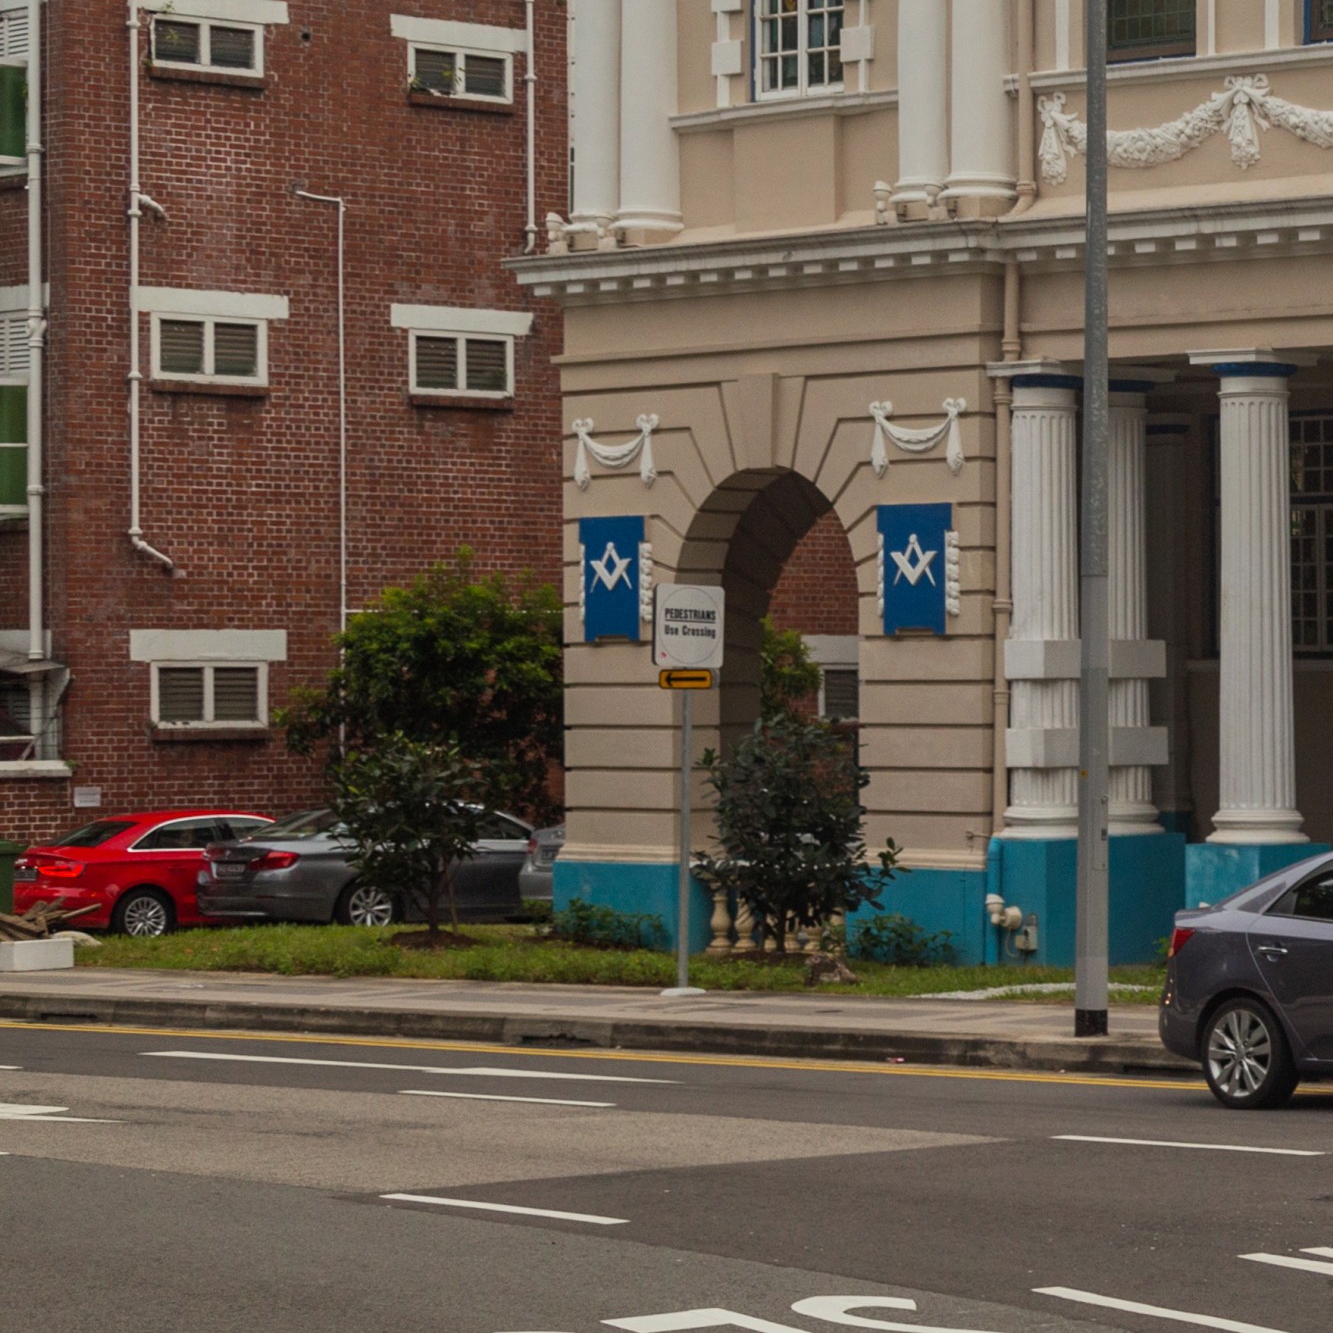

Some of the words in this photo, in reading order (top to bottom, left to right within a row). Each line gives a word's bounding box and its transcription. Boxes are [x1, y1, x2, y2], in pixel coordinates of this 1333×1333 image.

[665, 608, 717, 621] PEDESTRIANS
[664, 625, 679, 636] Use
[683, 625, 717, 638] Crossing
